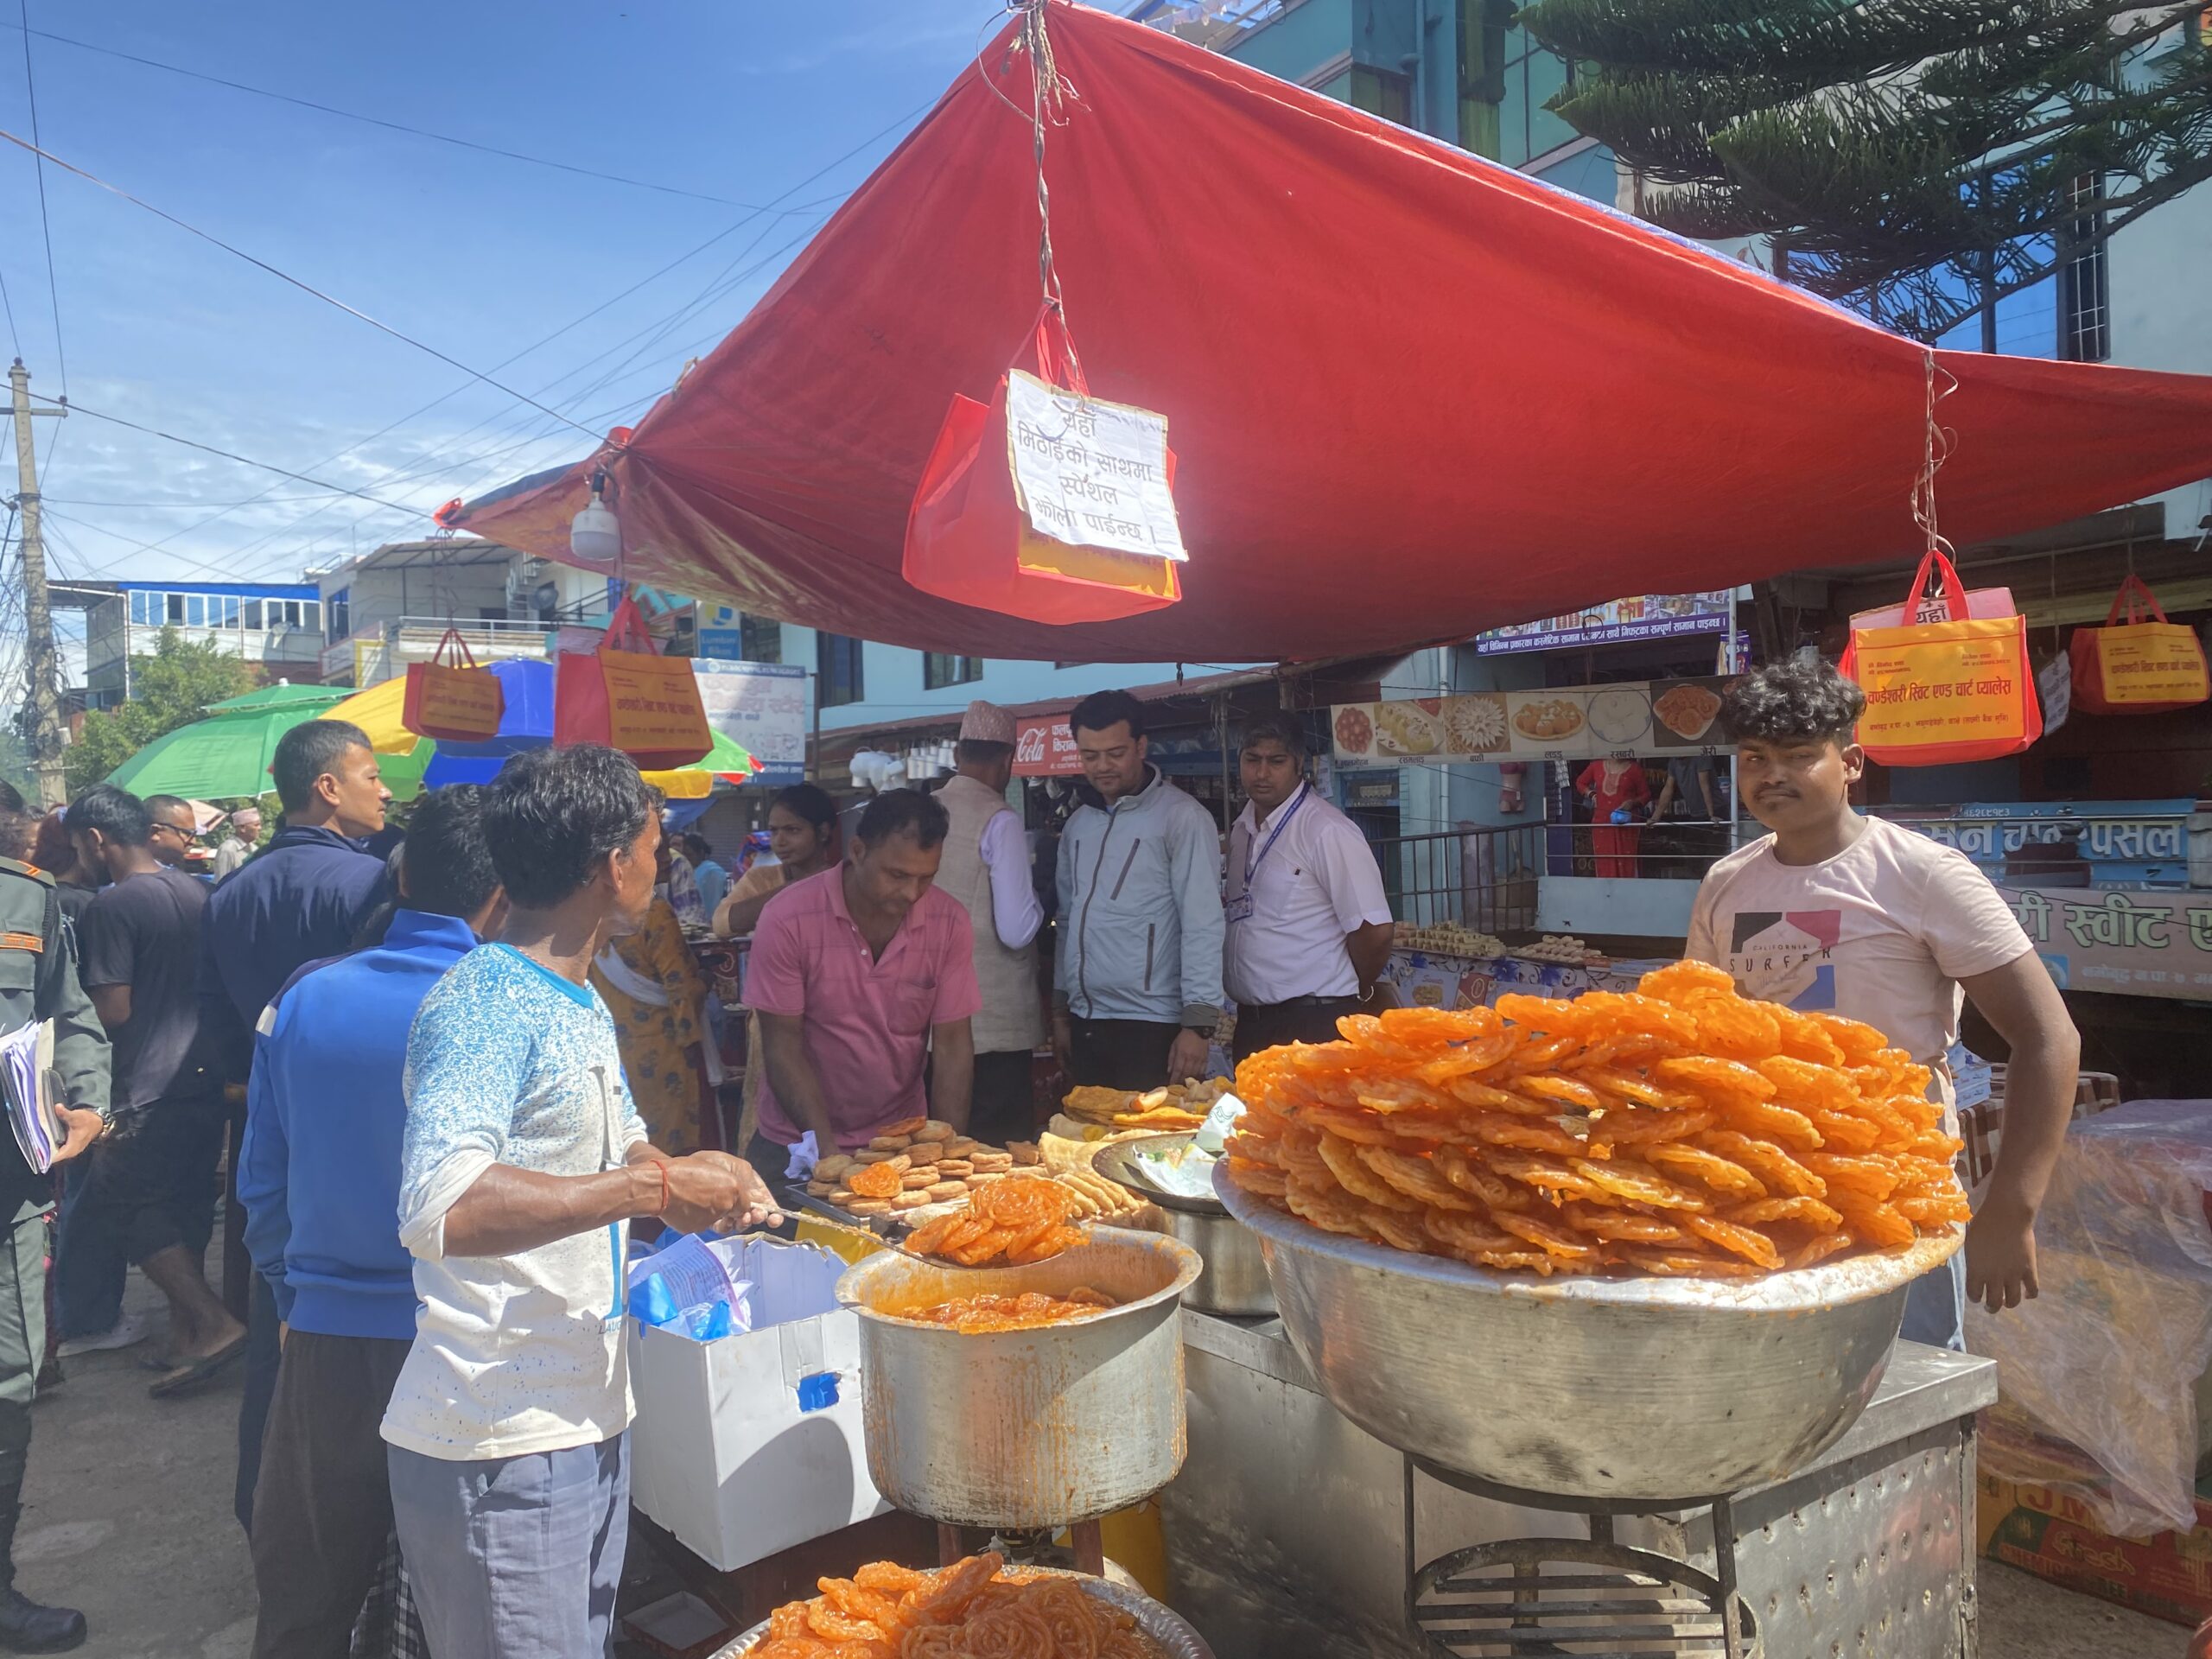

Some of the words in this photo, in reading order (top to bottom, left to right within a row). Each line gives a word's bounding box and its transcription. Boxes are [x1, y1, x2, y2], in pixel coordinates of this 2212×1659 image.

[1096, 452, 1153, 482] साथमा
[1673, 620, 1695, 632] सामान
[1916, 603, 1946, 623] यहाँ
[2063, 892, 2174, 949] स्वीट
[1729, 947, 1831, 973] SURFER
